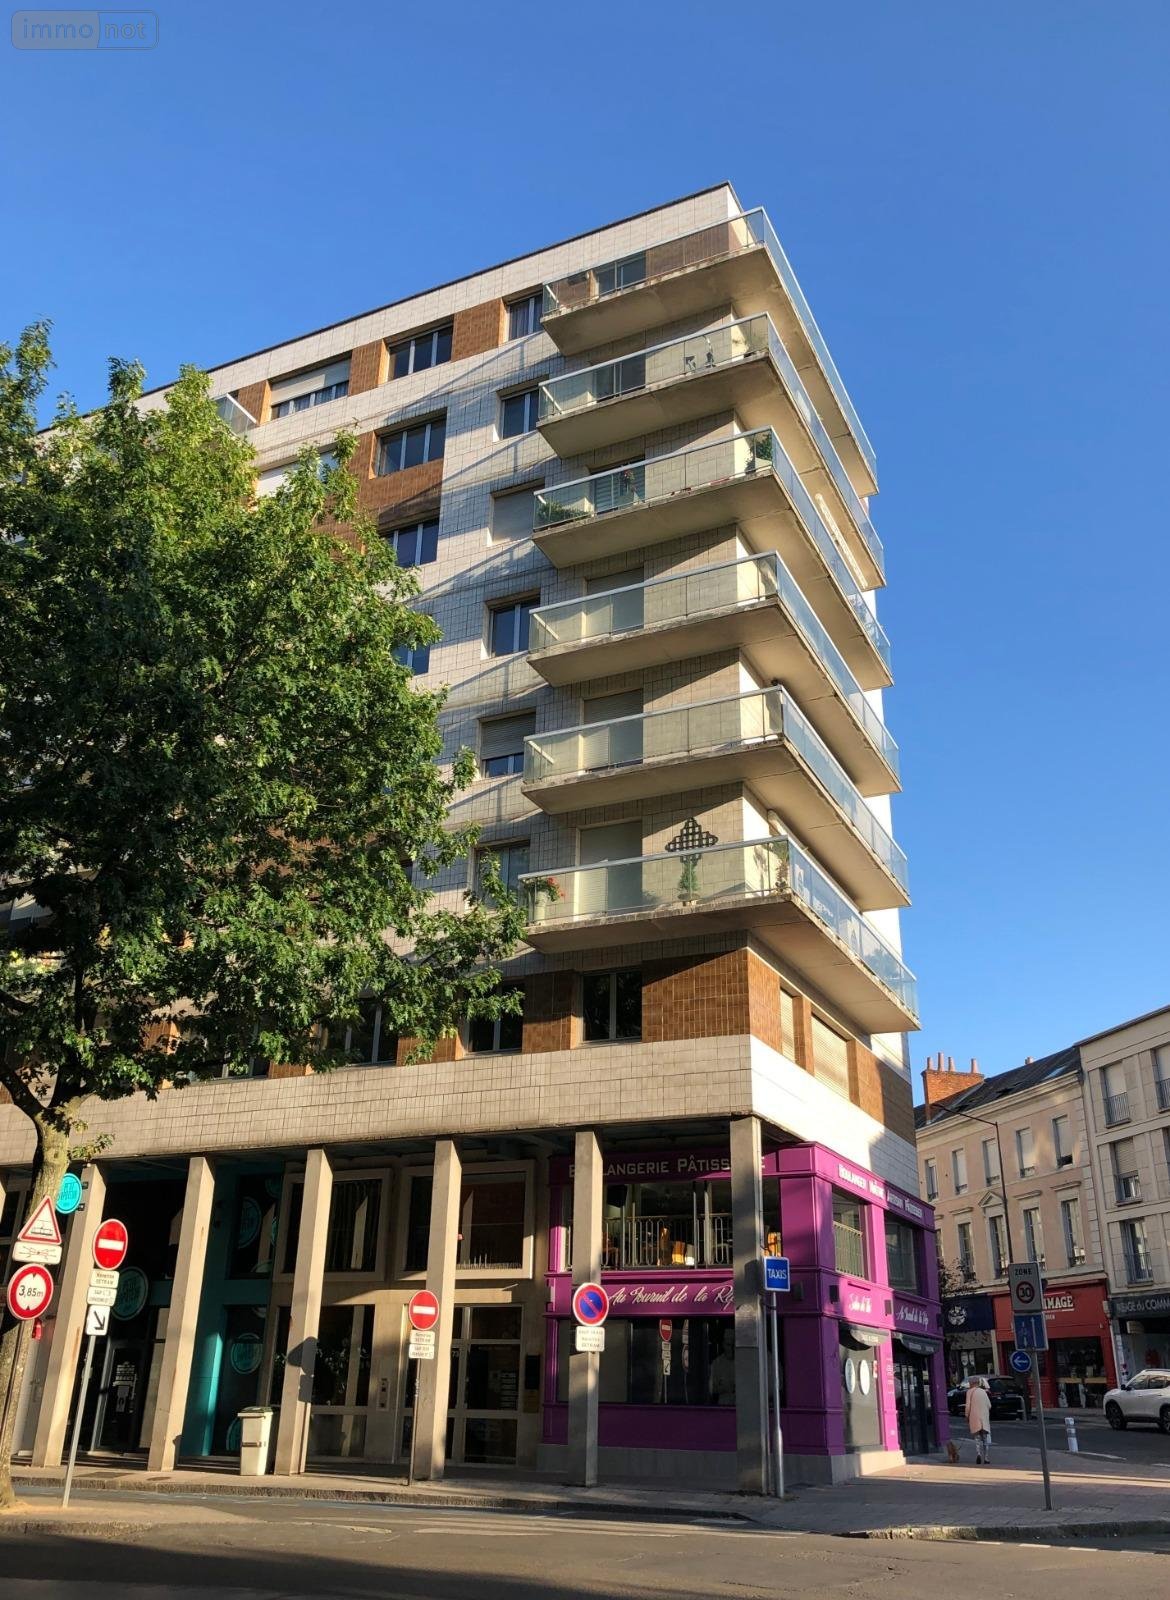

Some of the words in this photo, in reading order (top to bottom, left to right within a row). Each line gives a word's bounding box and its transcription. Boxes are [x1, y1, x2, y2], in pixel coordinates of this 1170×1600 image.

[768, 1269, 787, 1280] TAXIS
[609, 1287, 626, 1306] Au
[672, 1285, 688, 1303] de
[694, 1286, 708, 1303] la
[1019, 1287, 1032, 1298] 30
